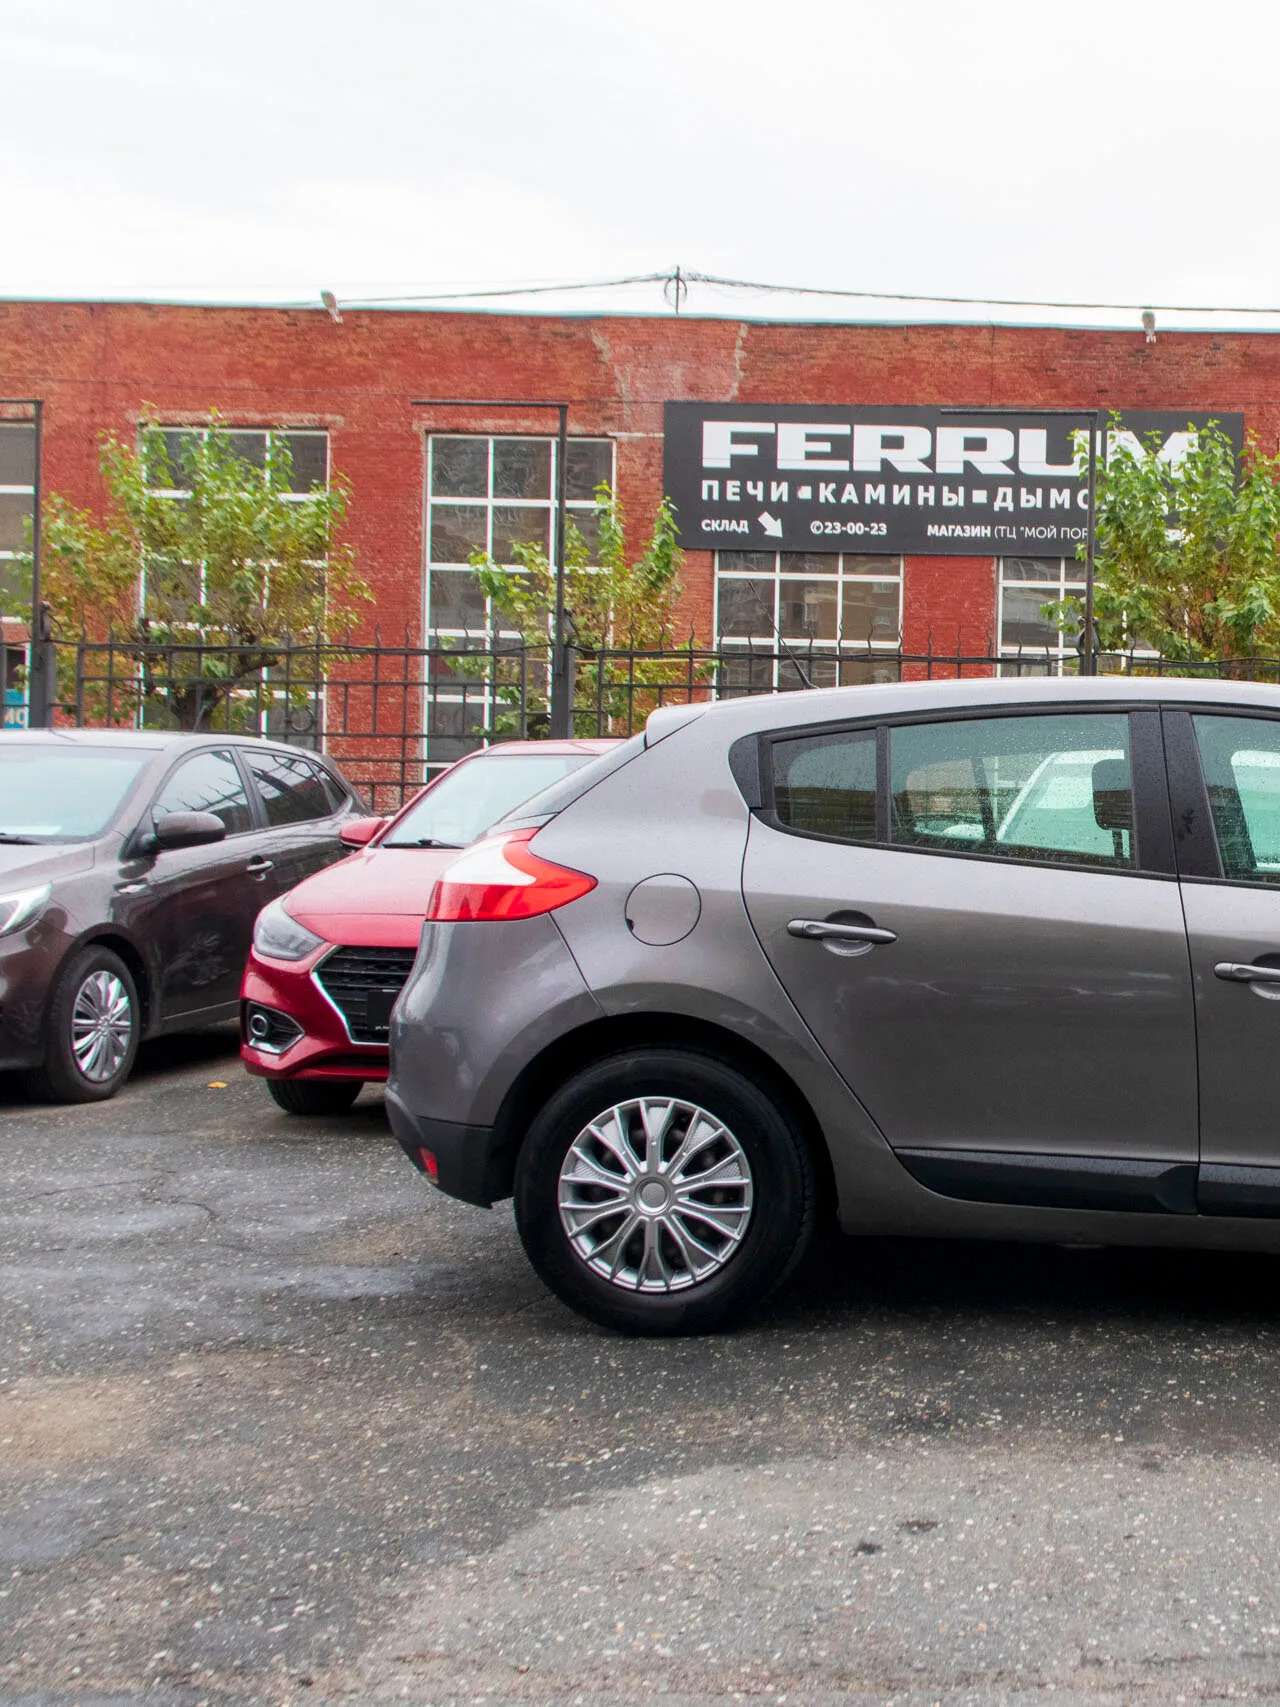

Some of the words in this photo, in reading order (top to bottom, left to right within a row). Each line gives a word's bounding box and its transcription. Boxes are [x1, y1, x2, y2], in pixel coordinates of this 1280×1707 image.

[701, 480, 789, 502] ПЕЧИ
[818, 482, 964, 507] КАМИНЫ
[701, 519, 749, 534] СКЛАД
[927, 525, 991, 538] МАГАЗИН
[994, 526, 1017, 540] (ТЦ
